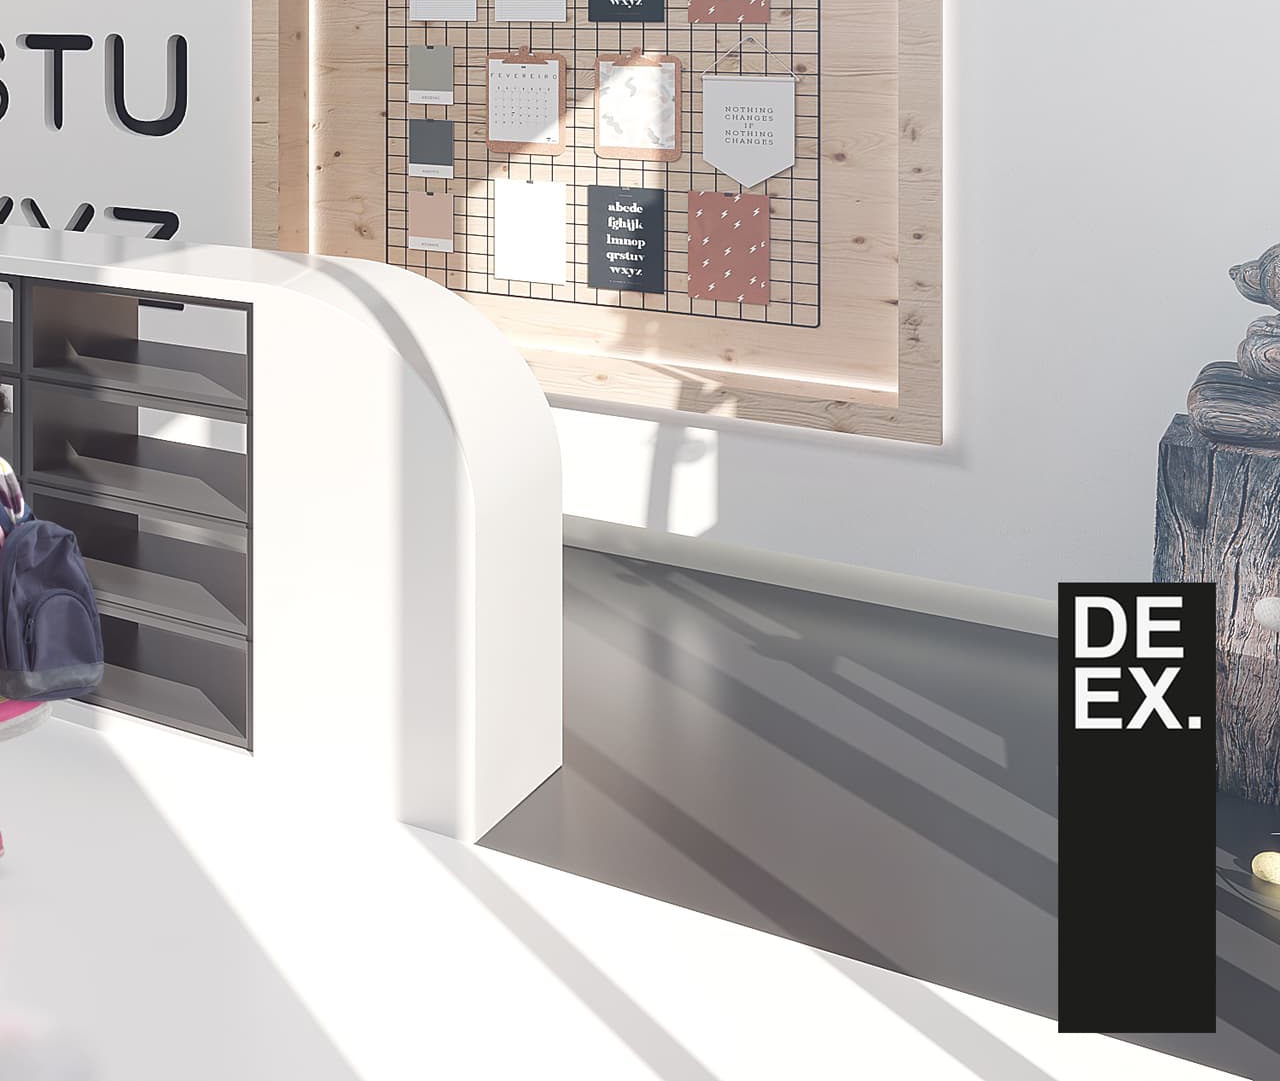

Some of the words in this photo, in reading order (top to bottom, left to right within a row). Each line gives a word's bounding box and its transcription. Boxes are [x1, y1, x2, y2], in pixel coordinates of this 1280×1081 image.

[725, 106, 774, 114] NOTHING
[725, 114, 774, 122] CHANGES
[725, 137, 774, 145] CHANGES
[608, 201, 643, 213] abcde
[608, 216, 644, 231] fghijk
[606, 234, 646, 249] lmnop
[606, 251, 645, 262] qrstuv
[609, 266, 643, 277] wxyz
